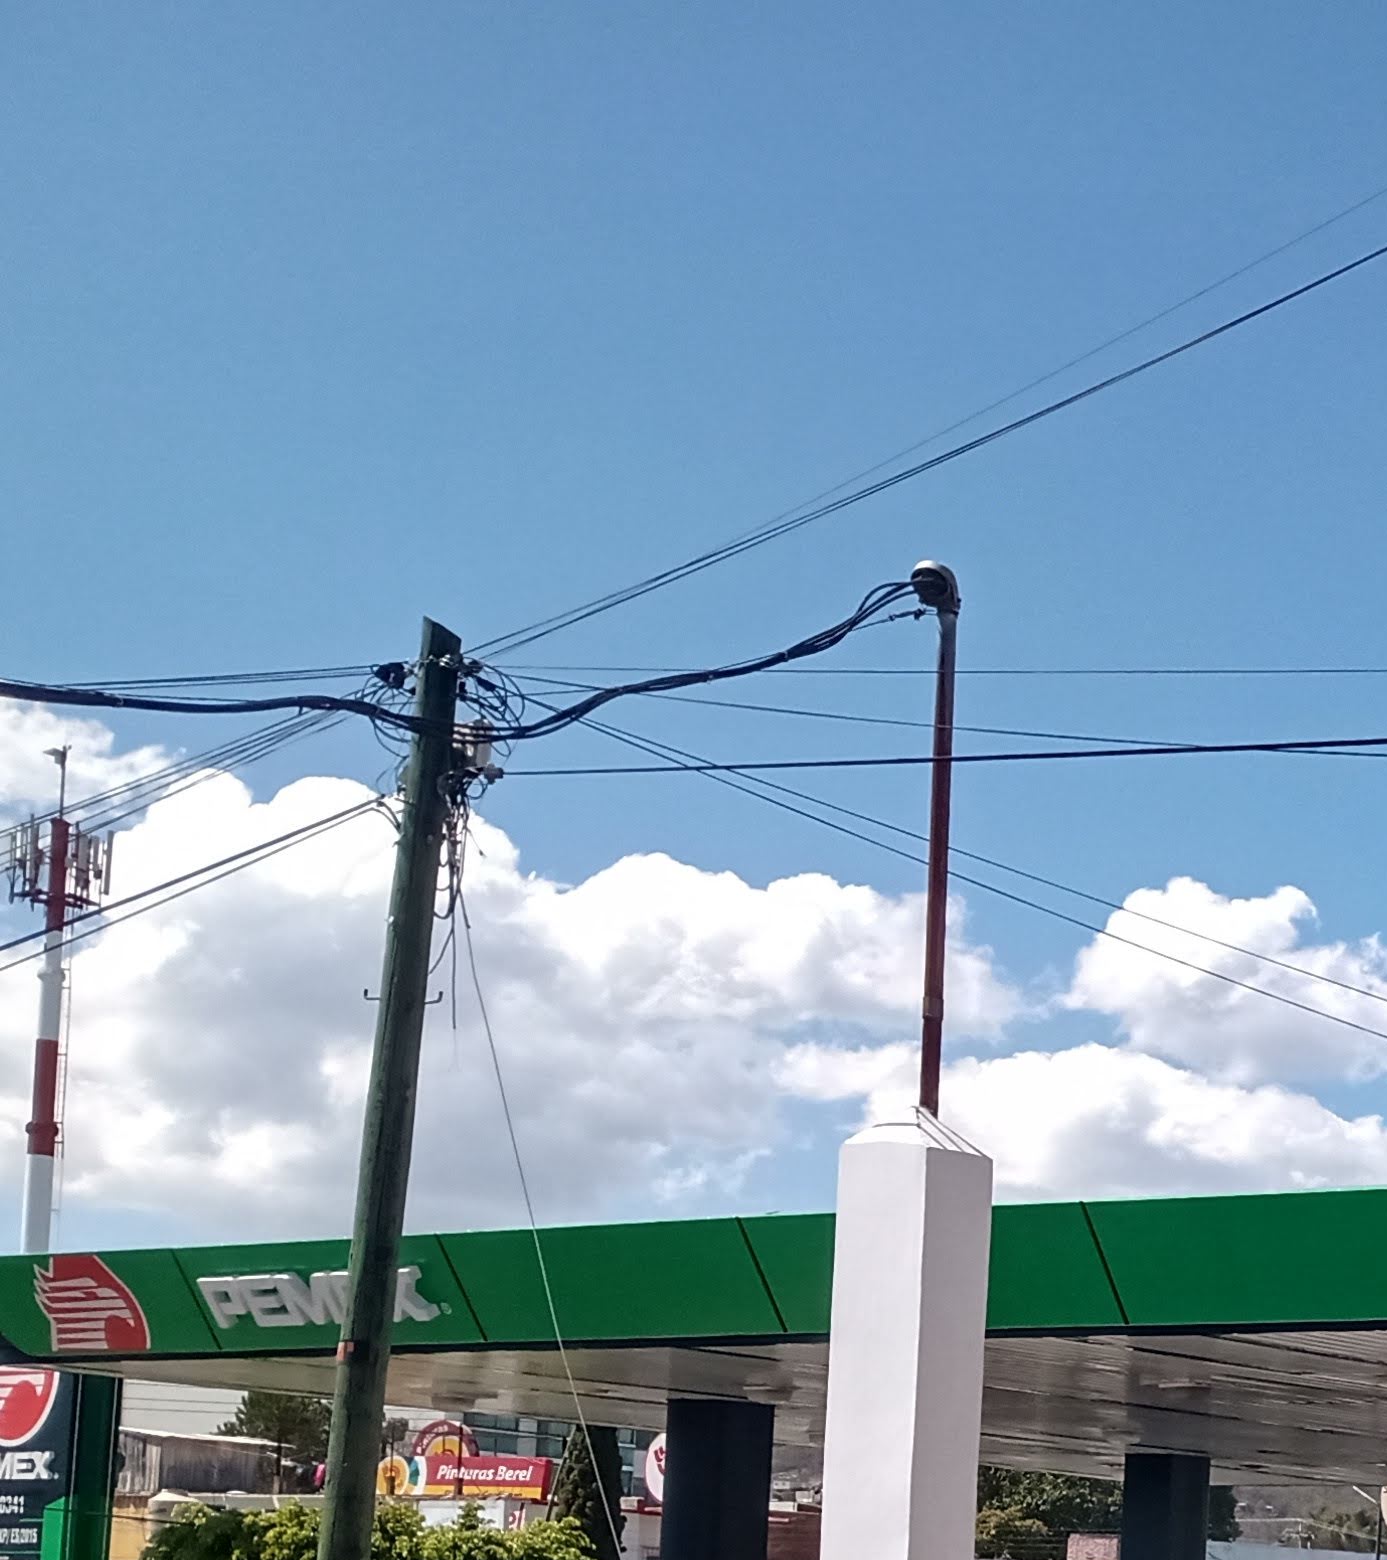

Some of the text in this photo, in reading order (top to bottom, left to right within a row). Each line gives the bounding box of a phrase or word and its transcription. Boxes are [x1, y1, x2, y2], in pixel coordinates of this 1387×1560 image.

[197, 1266, 441, 1329] PEMX
[436, 1464, 534, 1481] Pinturas Berel
